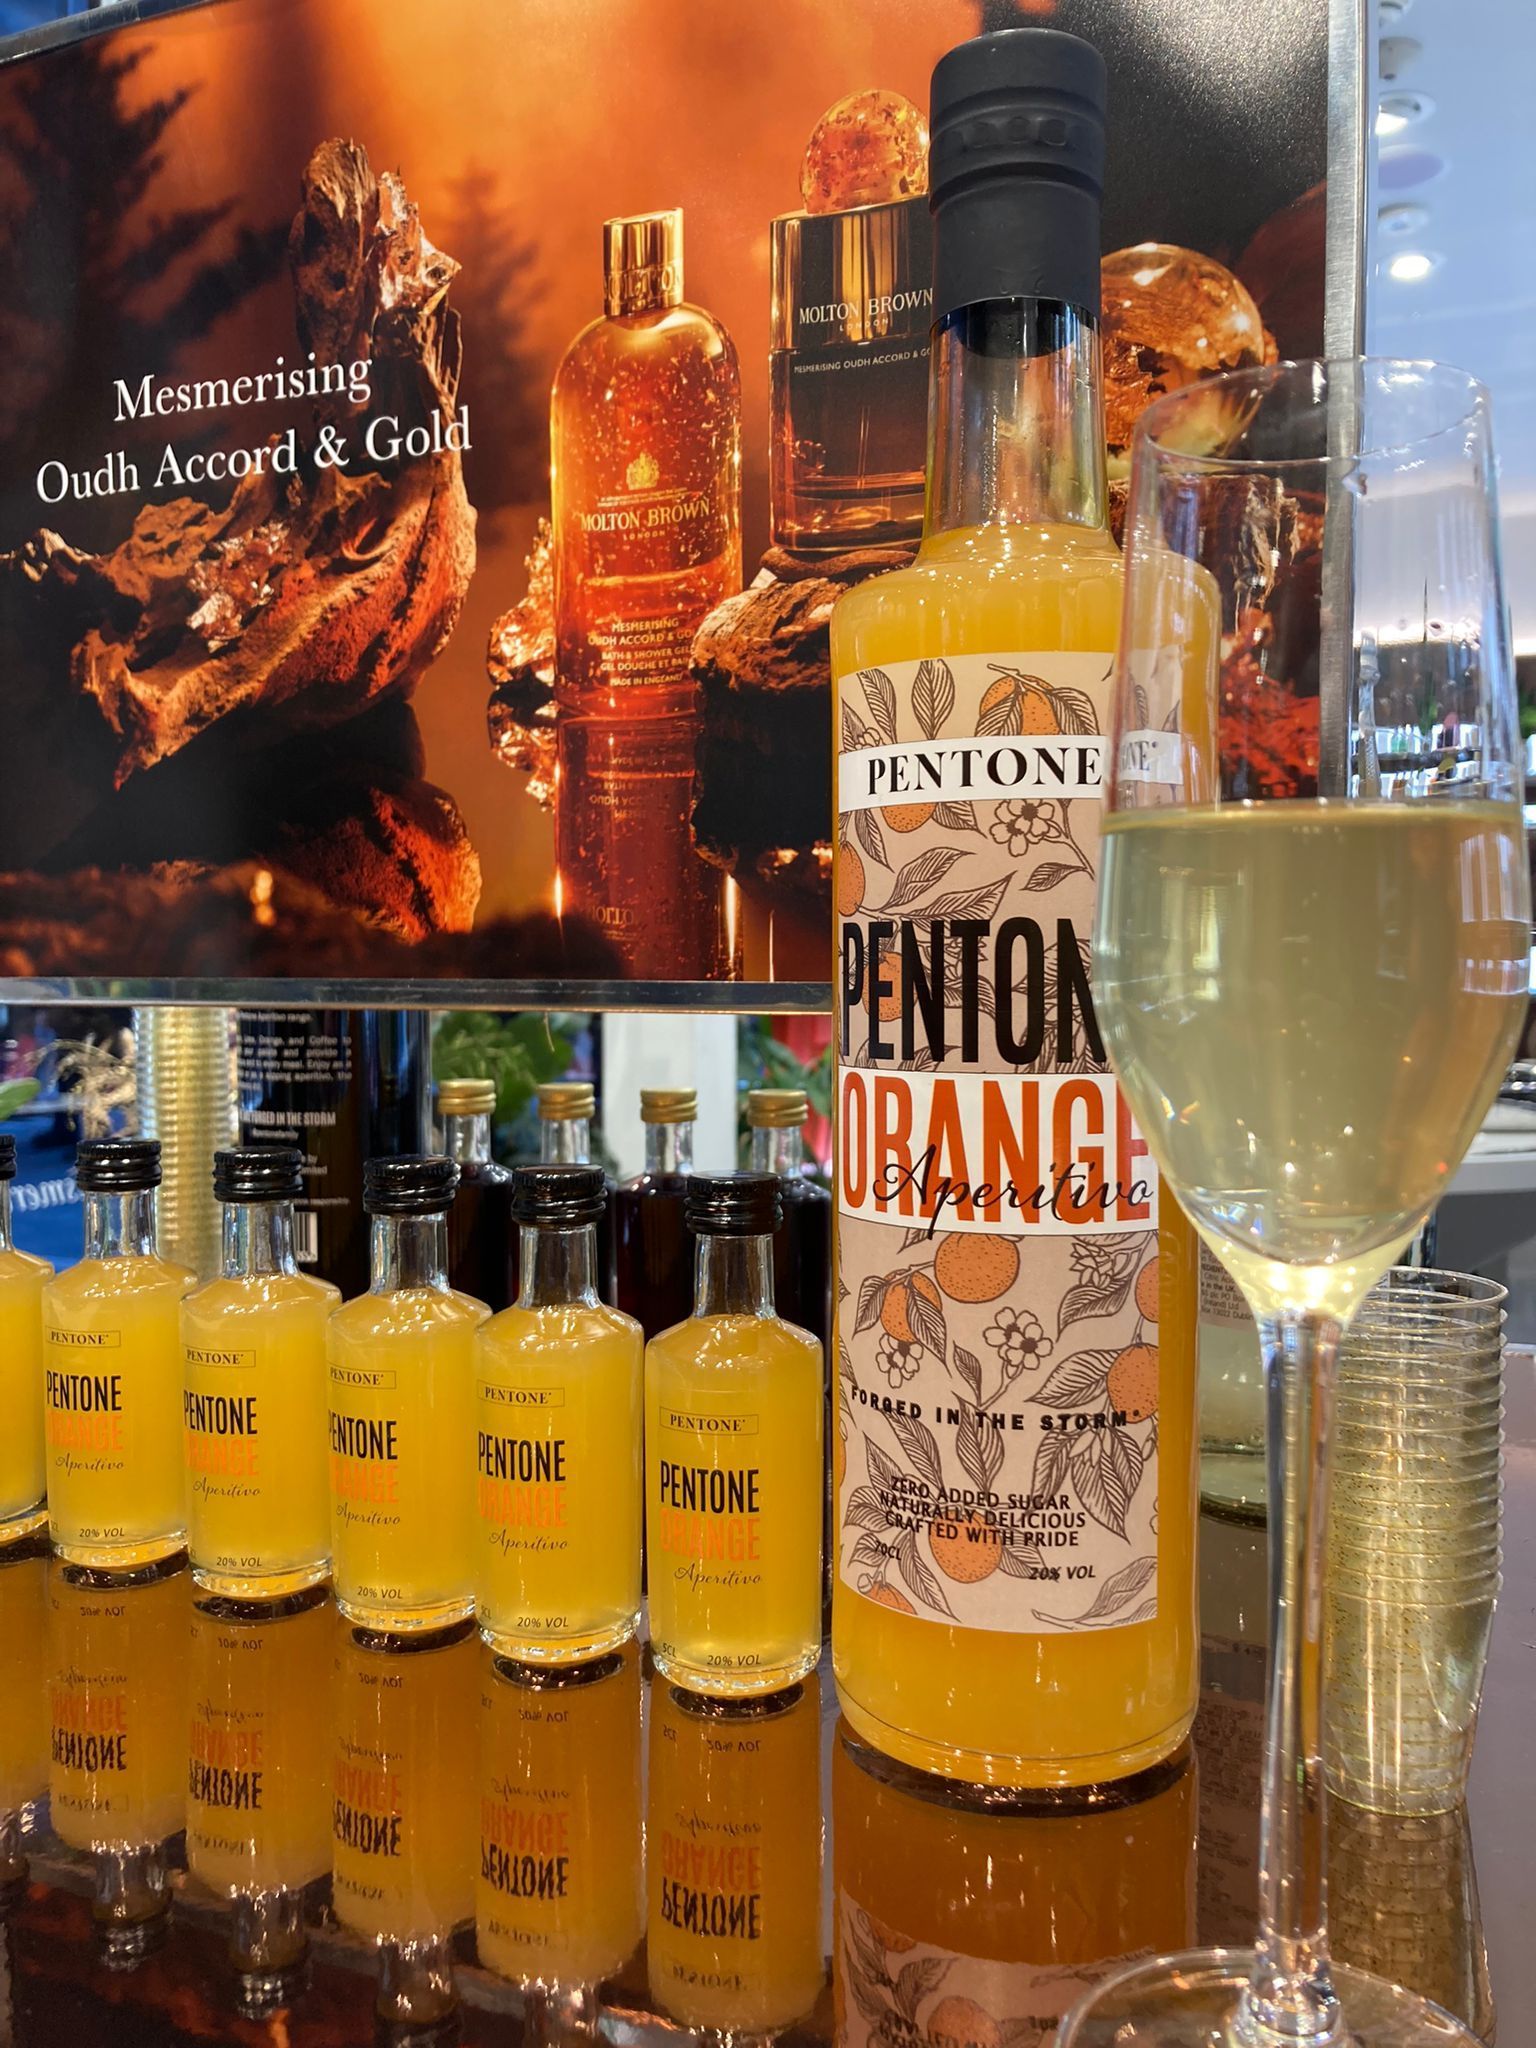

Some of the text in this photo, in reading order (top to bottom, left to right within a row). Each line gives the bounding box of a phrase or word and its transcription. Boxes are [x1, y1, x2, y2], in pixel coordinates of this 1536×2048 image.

[800, 288, 933, 324] MOLTON BROWN
[840, 318, 888, 331] LONDON
[794, 362, 841, 373] MESMERISING
[844, 358, 871, 369] OUDH
[872, 352, 910, 365] ACCORD
[913, 350, 918, 358] &
[113, 352, 372, 421] Mesmerising
[36, 406, 472, 503] Oudh Accord & Gold
[580, 511, 640, 531] MOLTON
[647, 496, 710, 527] BROWN
[623, 530, 665, 540] LONDON
[612, 618, 679, 632] MESMERISING
[619, 633, 664, 645] ACCORD
[601, 662, 615, 671] GEL
[618, 661, 656, 670] DOUCHE
[659, 660, 668, 668] ET
[634, 648, 672, 658] SHOWER
[304, 1112, 336, 1126] STORM
[842, 1072, 1151, 1225] ORANGE
[872, 1143, 1153, 1240] Aperitivo
[46, 1369, 122, 1412] PENTONE
[183, 1389, 258, 1435] PENTONE
[851, 1385, 922, 1419] FORGED
[936, 1407, 960, 1425] IN
[975, 1411, 1025, 1431] THE
[327, 1408, 398, 1460] PENTONE
[56, 1453, 124, 1477] Aperitivo
[478, 1431, 566, 1482] PENTONE
[193, 1476, 260, 1503] Aperitivo
[478, 1476, 567, 1529] ORANGE
[660, 1460, 760, 1514] PENTONE
[891, 1476, 1071, 1510] ZERO ADDED SUGAR
[336, 1501, 401, 1529] Aperitivo
[879, 1491, 1086, 1528] NATURALLY DELICIOUS
[79, 1527, 125, 1538] 20% VOL
[489, 1528, 568, 1556] Aperitivo
[659, 1507, 760, 1561] ORANGE
[884, 1511, 1079, 1547] CRAFTED WITH PRIDE
[216, 1556, 263, 1567] 20% VOL
[874, 1540, 1096, 1583] 70CL 20% VOL
[357, 1586, 403, 1599] 20% VOL
[674, 1563, 761, 1592] Aperitivo
[517, 1616, 541, 1628] 20%
[545, 1617, 569, 1628] VOL
[707, 1654, 732, 1666] 20%
[737, 1654, 762, 1666] VOL
